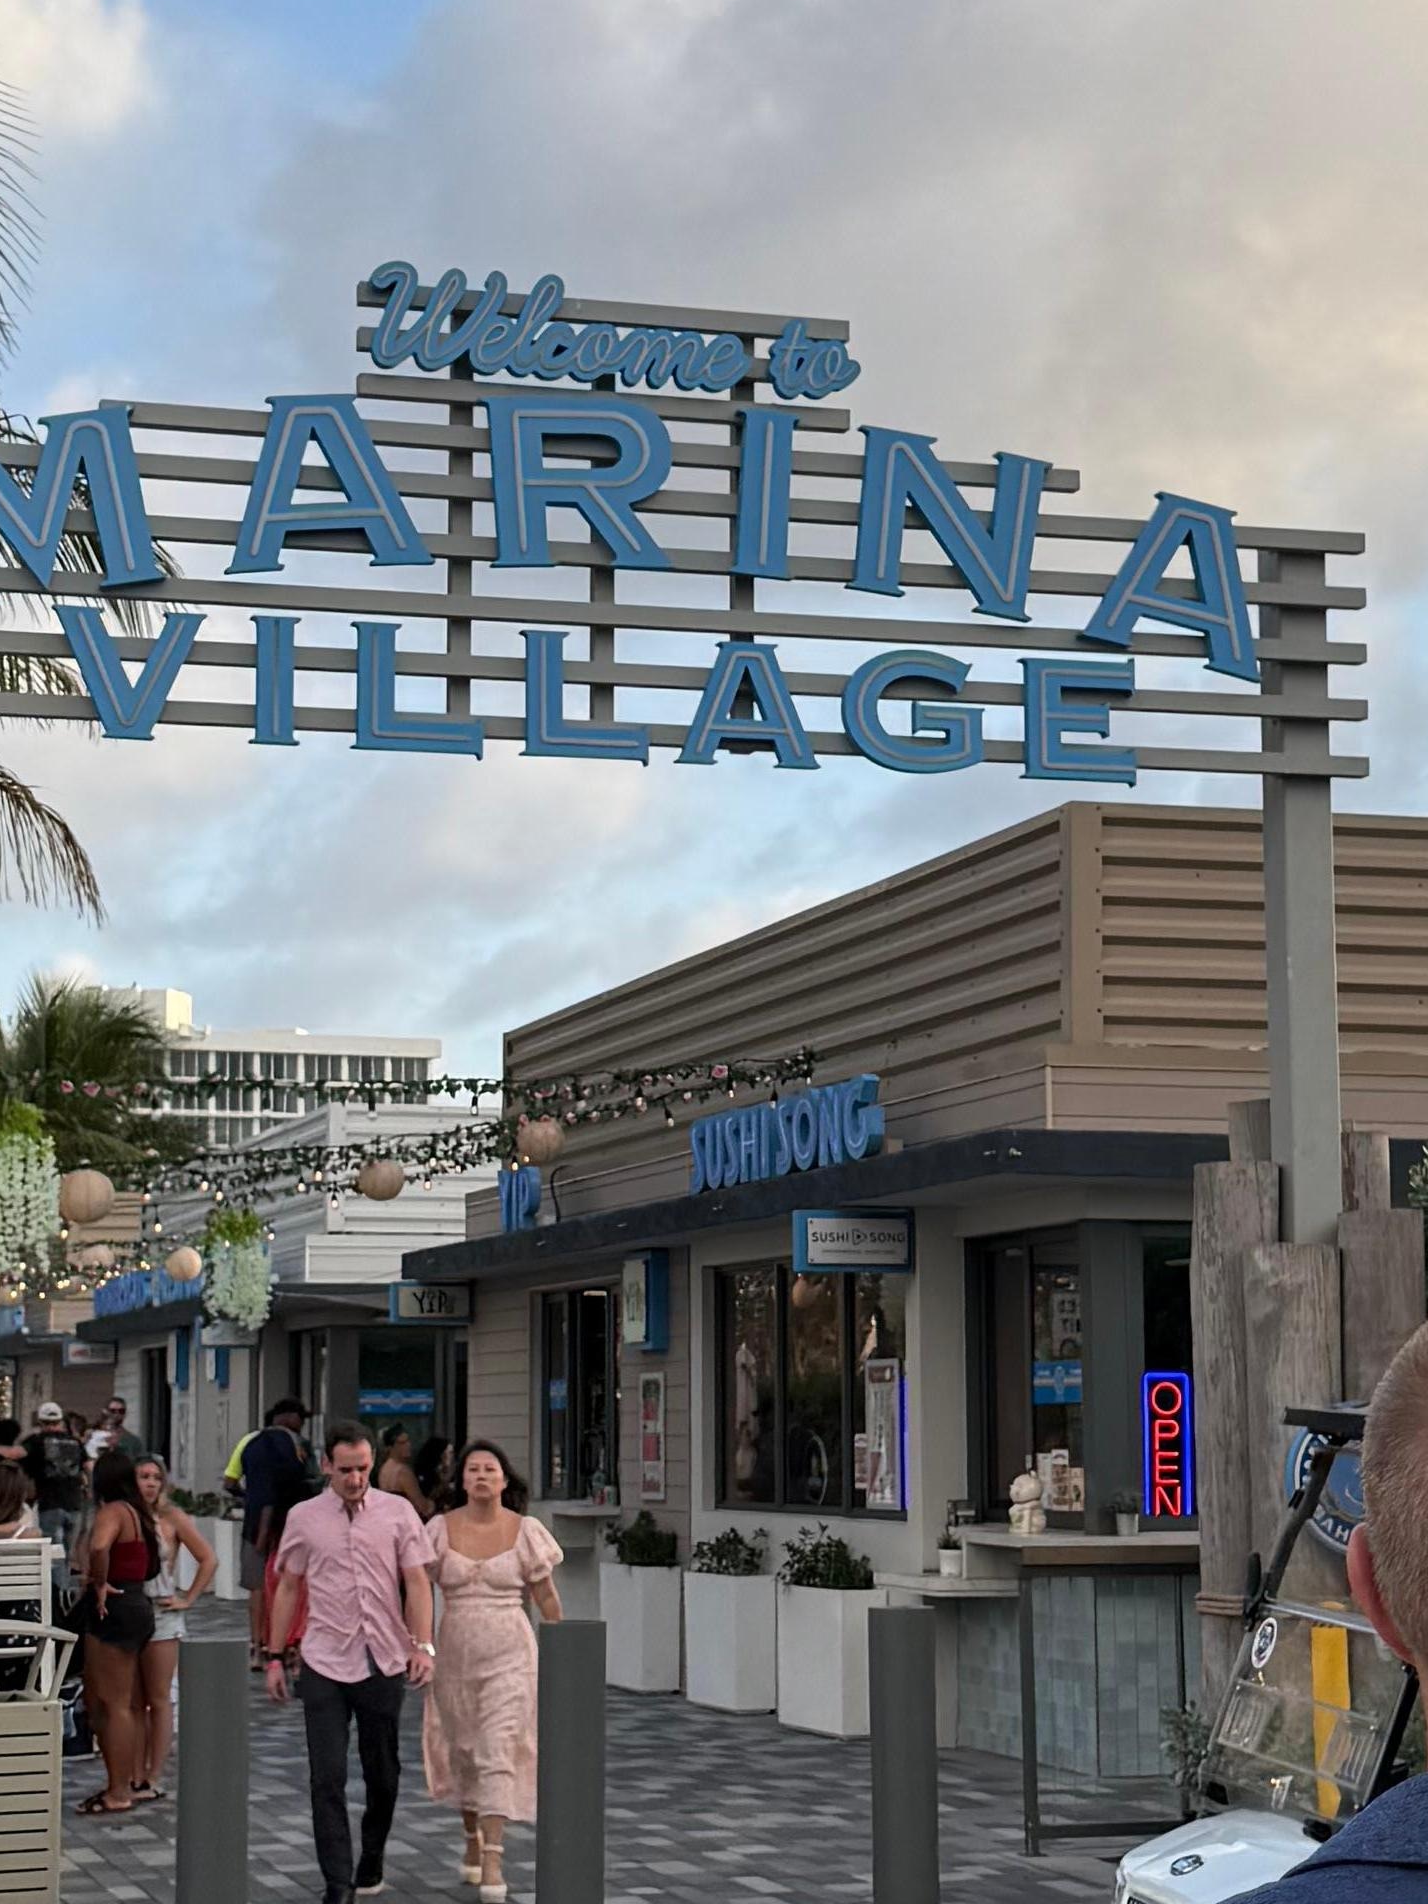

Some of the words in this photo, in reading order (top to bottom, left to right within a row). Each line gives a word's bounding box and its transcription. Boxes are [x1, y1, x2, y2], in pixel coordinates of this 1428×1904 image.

[371, 260, 750, 393] Welcome
[769, 318, 861, 400] to
[54, 602, 1139, 786] VILLAGE
[689, 1104, 771, 1196] SUSHI
[774, 1075, 883, 1176] SONG
[811, 1231, 849, 1244] SUSHI
[869, 1231, 906, 1244] SONG
[1150, 1380, 1182, 1518] OPEN
